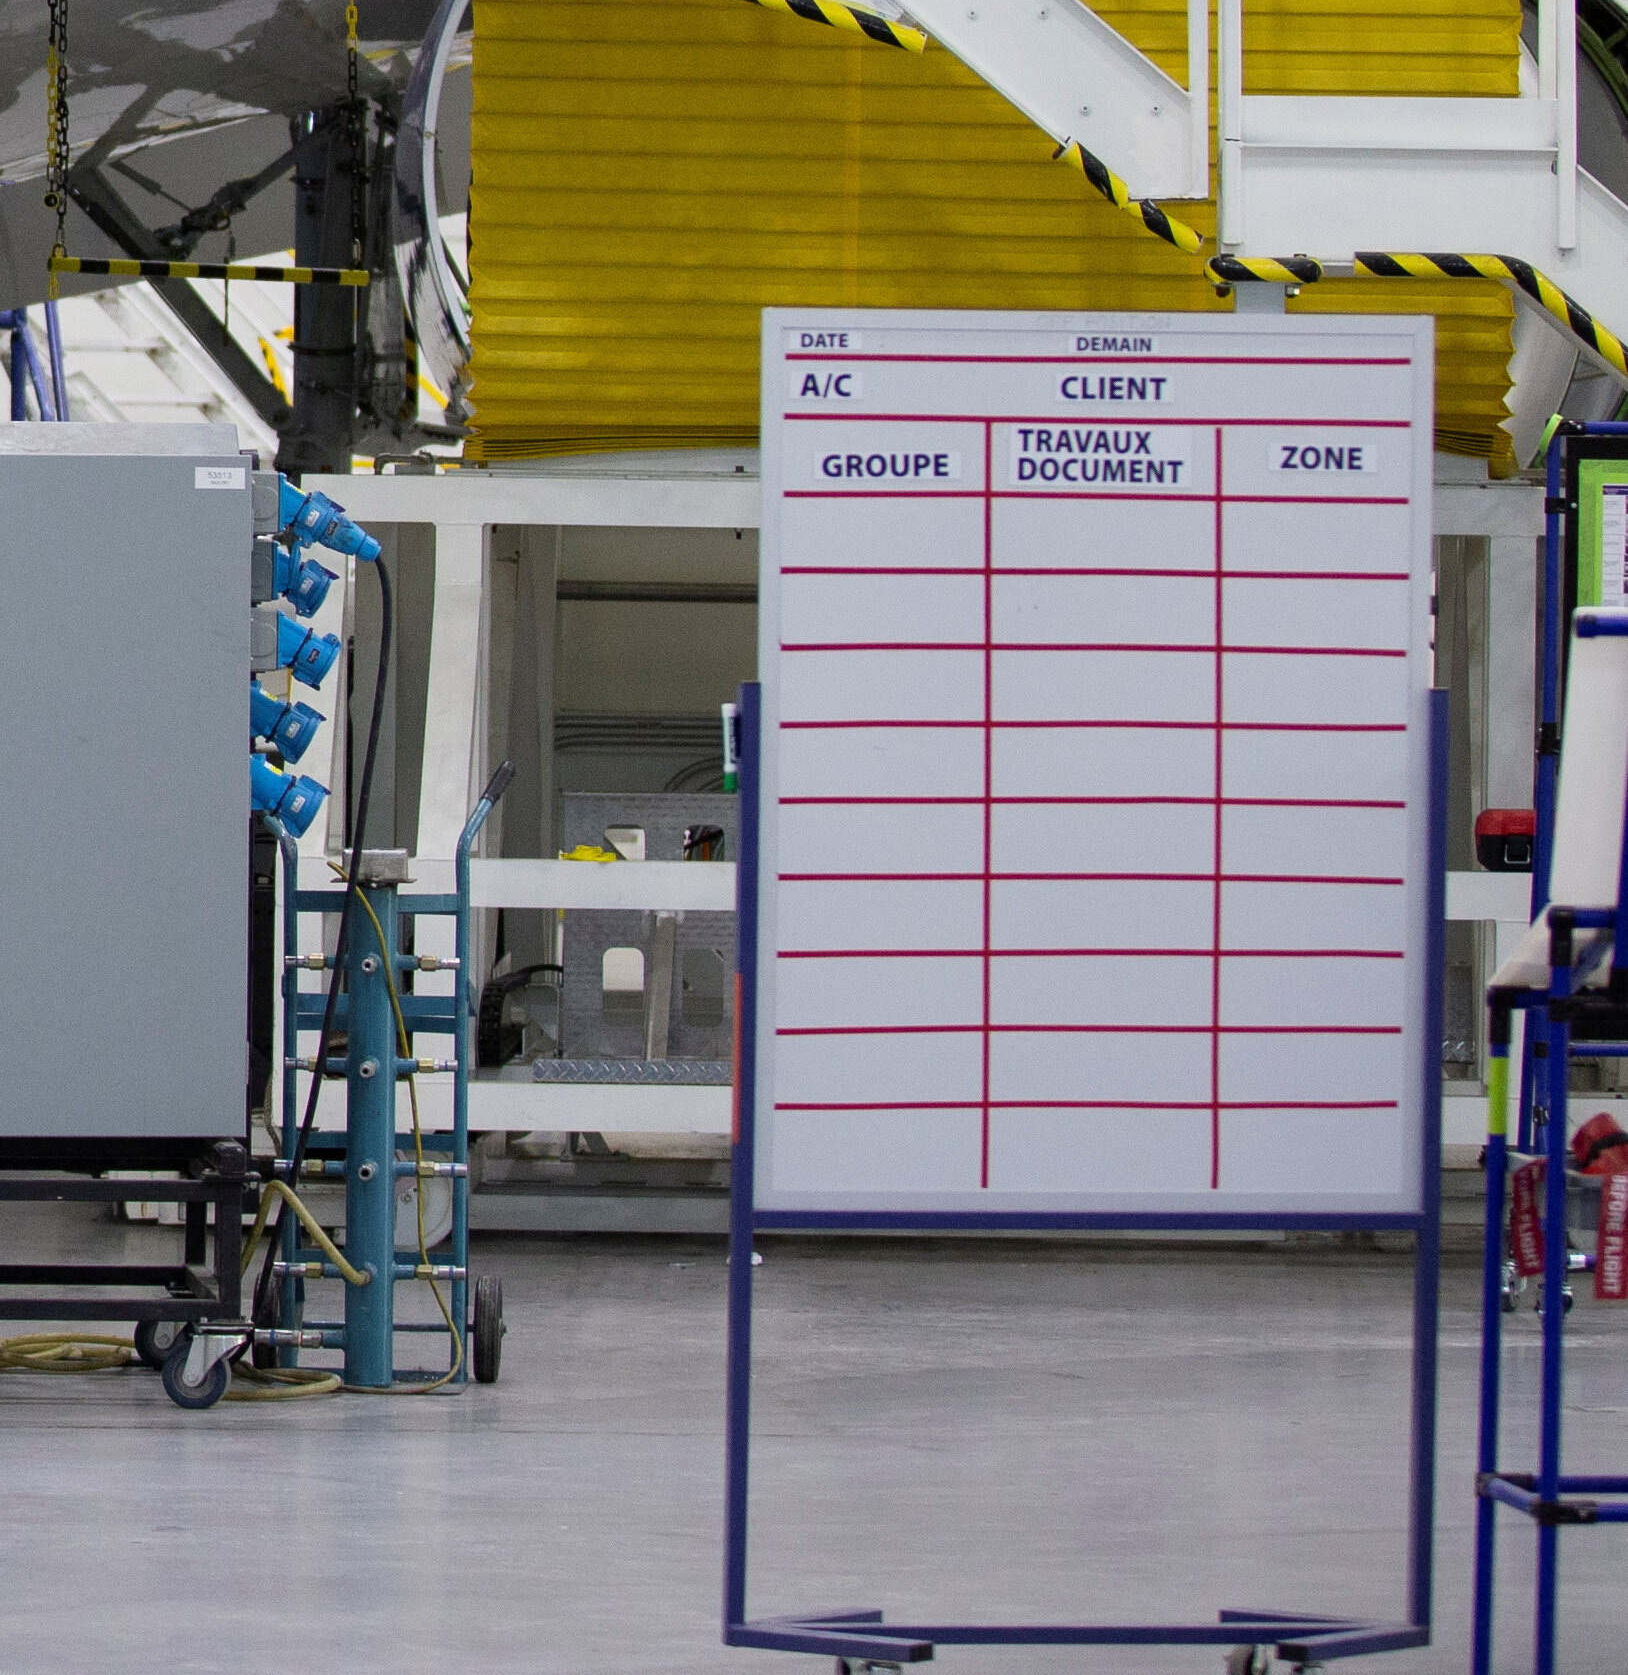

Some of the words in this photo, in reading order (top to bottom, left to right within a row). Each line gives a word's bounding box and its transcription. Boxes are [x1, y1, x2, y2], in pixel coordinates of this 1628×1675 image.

[800, 333, 849, 348] DATE
[1076, 337, 1152, 352] DEMAIN
[800, 374, 852, 397] A/C
[1061, 377, 1166, 400] CLIENT
[1018, 428, 1151, 454] TRAVAUX
[822, 454, 949, 477] GROUPE
[1018, 458, 1182, 483] DOCUMENT
[1281, 446, 1363, 470] ZONE
[1603, 1236, 1625, 1294] FLIGHT
